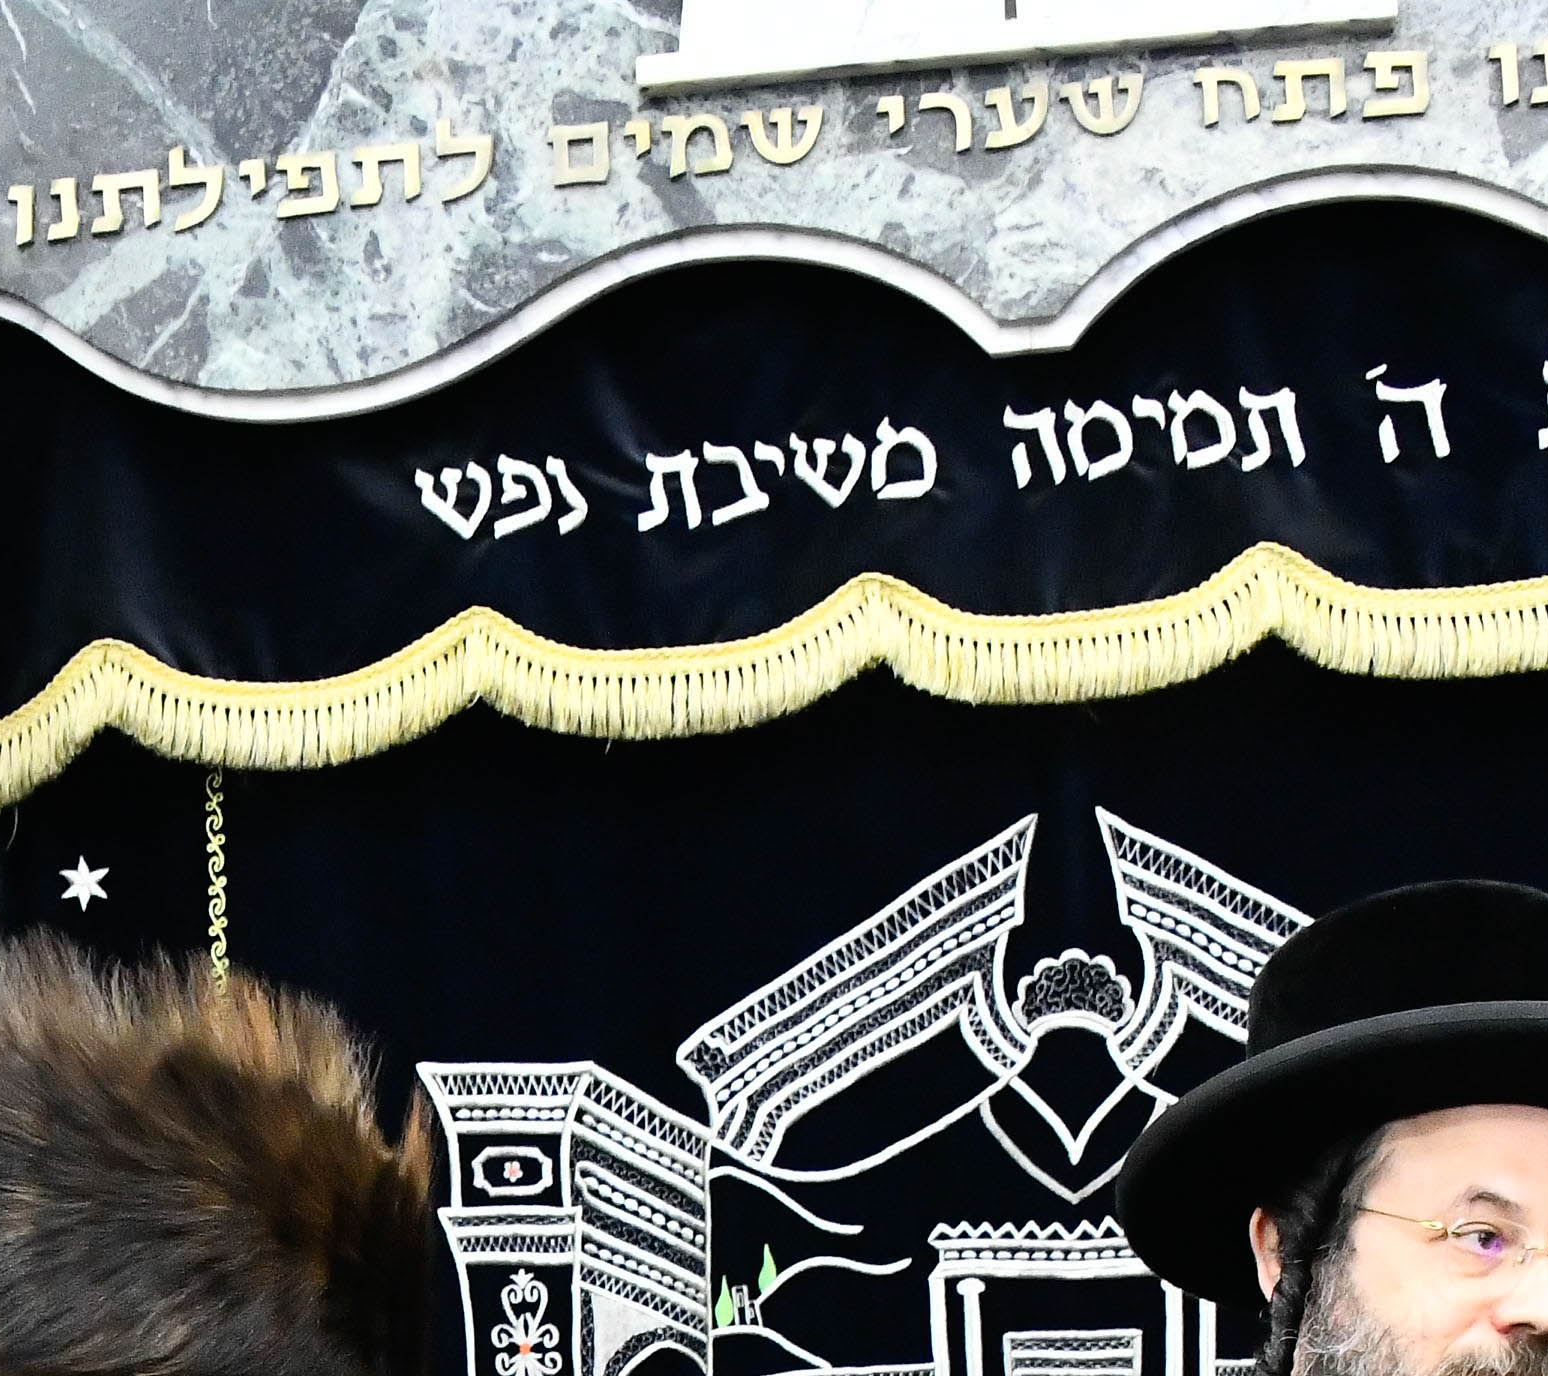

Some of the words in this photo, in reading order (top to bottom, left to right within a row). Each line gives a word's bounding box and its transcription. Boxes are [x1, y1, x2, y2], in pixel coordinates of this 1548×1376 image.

[876, 70, 1144, 154] שערי
[1193, 49, 1431, 129] פתח
[7, 119, 495, 248] לתפילתנו
[547, 105, 824, 188] שמים
[637, 416, 938, 532] משיבת
[1002, 386, 1306, 490] תמימה
[414, 458, 589, 540] נפש
